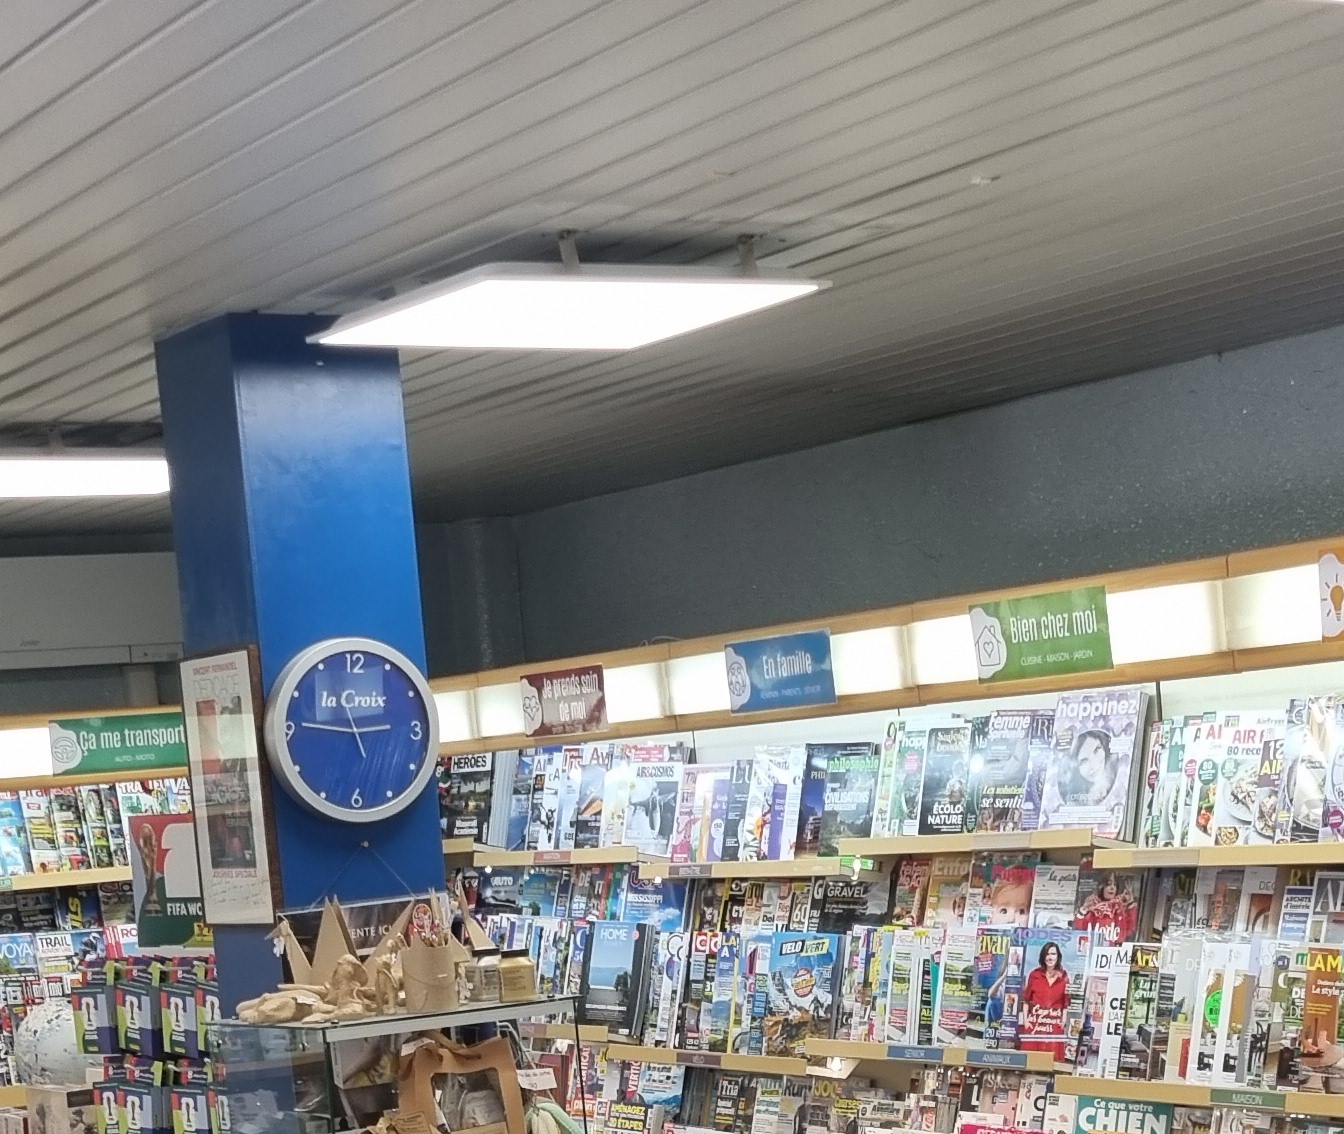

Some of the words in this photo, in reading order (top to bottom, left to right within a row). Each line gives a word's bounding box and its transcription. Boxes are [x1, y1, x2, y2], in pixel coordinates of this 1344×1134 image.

[1010, 616, 1038, 644] Bien
[1041, 611, 1069, 639] chez
[1071, 605, 1097, 634] moi
[346, 653, 364, 674] 12
[762, 655, 774, 679] En
[777, 651, 811, 676] famille
[321, 691, 336, 707] la
[340, 689, 387, 708] Croix
[100, 731, 121, 747] me
[125, 724, 186, 746] transport
[285, 722, 295, 741] 9
[410, 721, 422, 740] 3
[351, 788, 362, 808] 6
[928, 814, 962, 826] NATURE
[827, 885, 866, 899] GRAVEL
[600, 928, 628, 941] HOME
